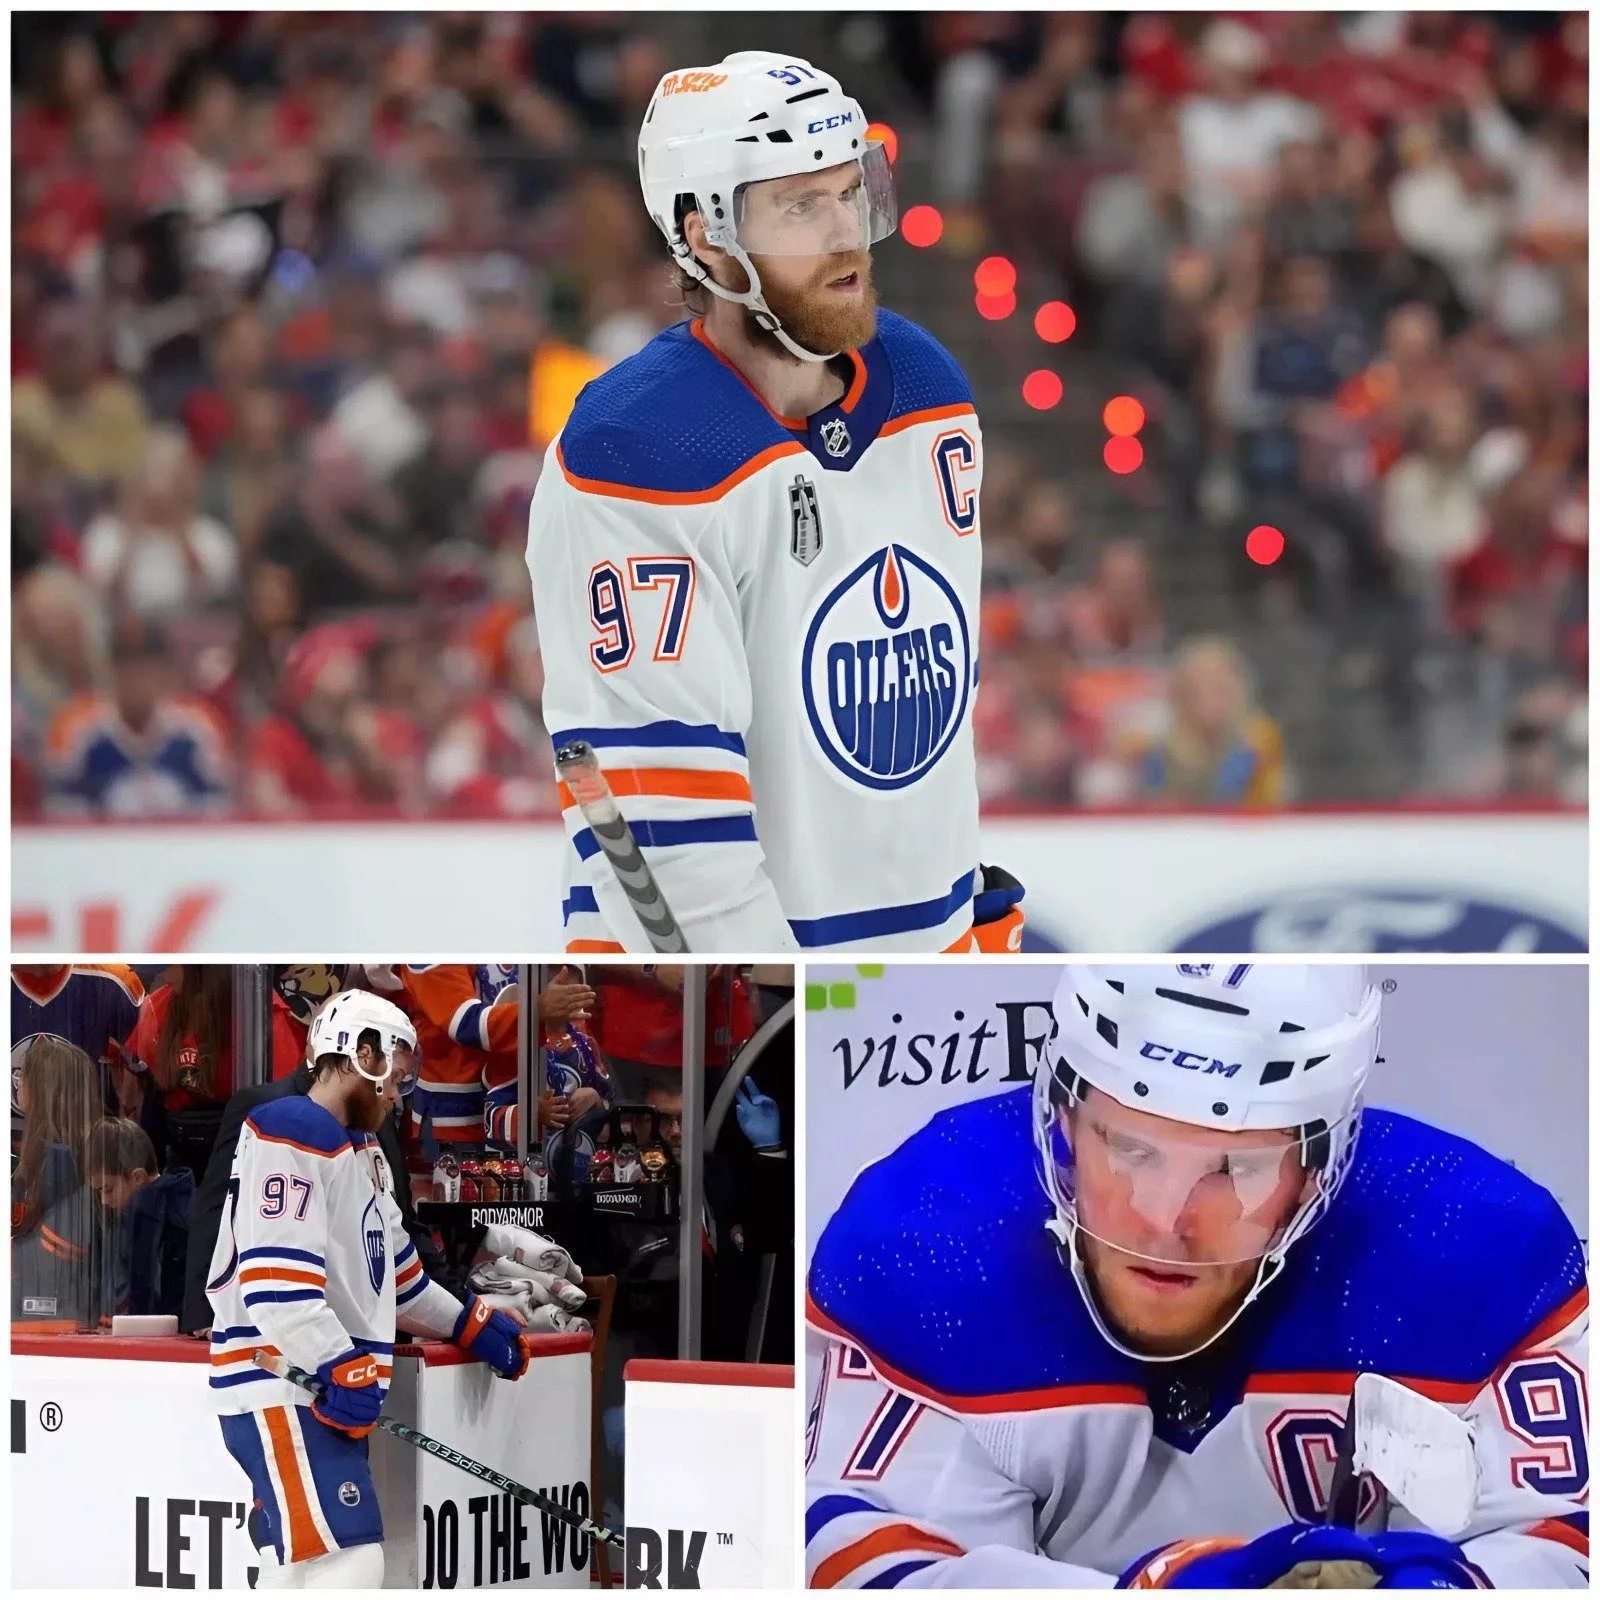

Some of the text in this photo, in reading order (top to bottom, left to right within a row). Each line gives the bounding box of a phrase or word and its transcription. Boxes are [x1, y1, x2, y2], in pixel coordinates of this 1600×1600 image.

[765, 64, 818, 86] 97
[807, 112, 853, 134] CCM
[931, 428, 977, 537] C
[587, 556, 697, 675] 97
[827, 622, 957, 758] OILERS
[1139, 1041, 1243, 1079] CCM
[260, 1173, 313, 1221] 97
[471, 1207, 544, 1228] BODYARMOR
[425, 1440, 518, 1491] JETSPEED
[469, 1493, 531, 1587] THE
